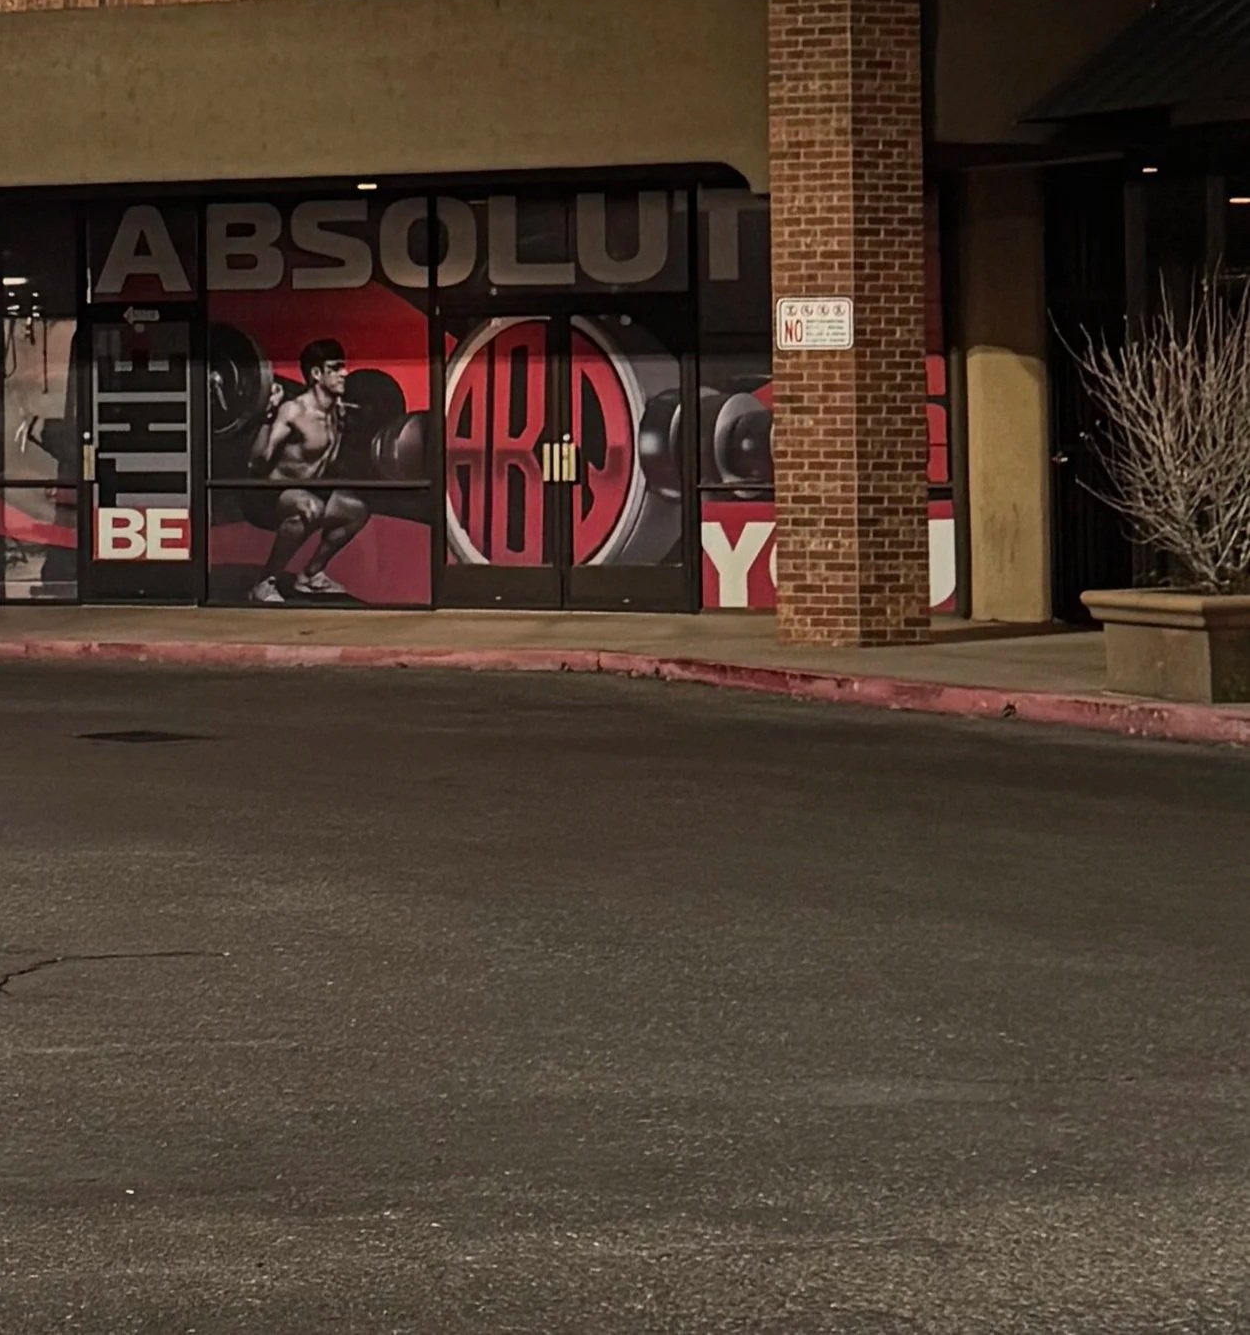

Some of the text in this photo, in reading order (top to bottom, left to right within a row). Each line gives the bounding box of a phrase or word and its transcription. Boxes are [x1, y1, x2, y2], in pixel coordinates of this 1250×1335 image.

[95, 189, 768, 293] ABSOLUT
[784, 319, 804, 343] NO
[98, 507, 190, 560] BE
